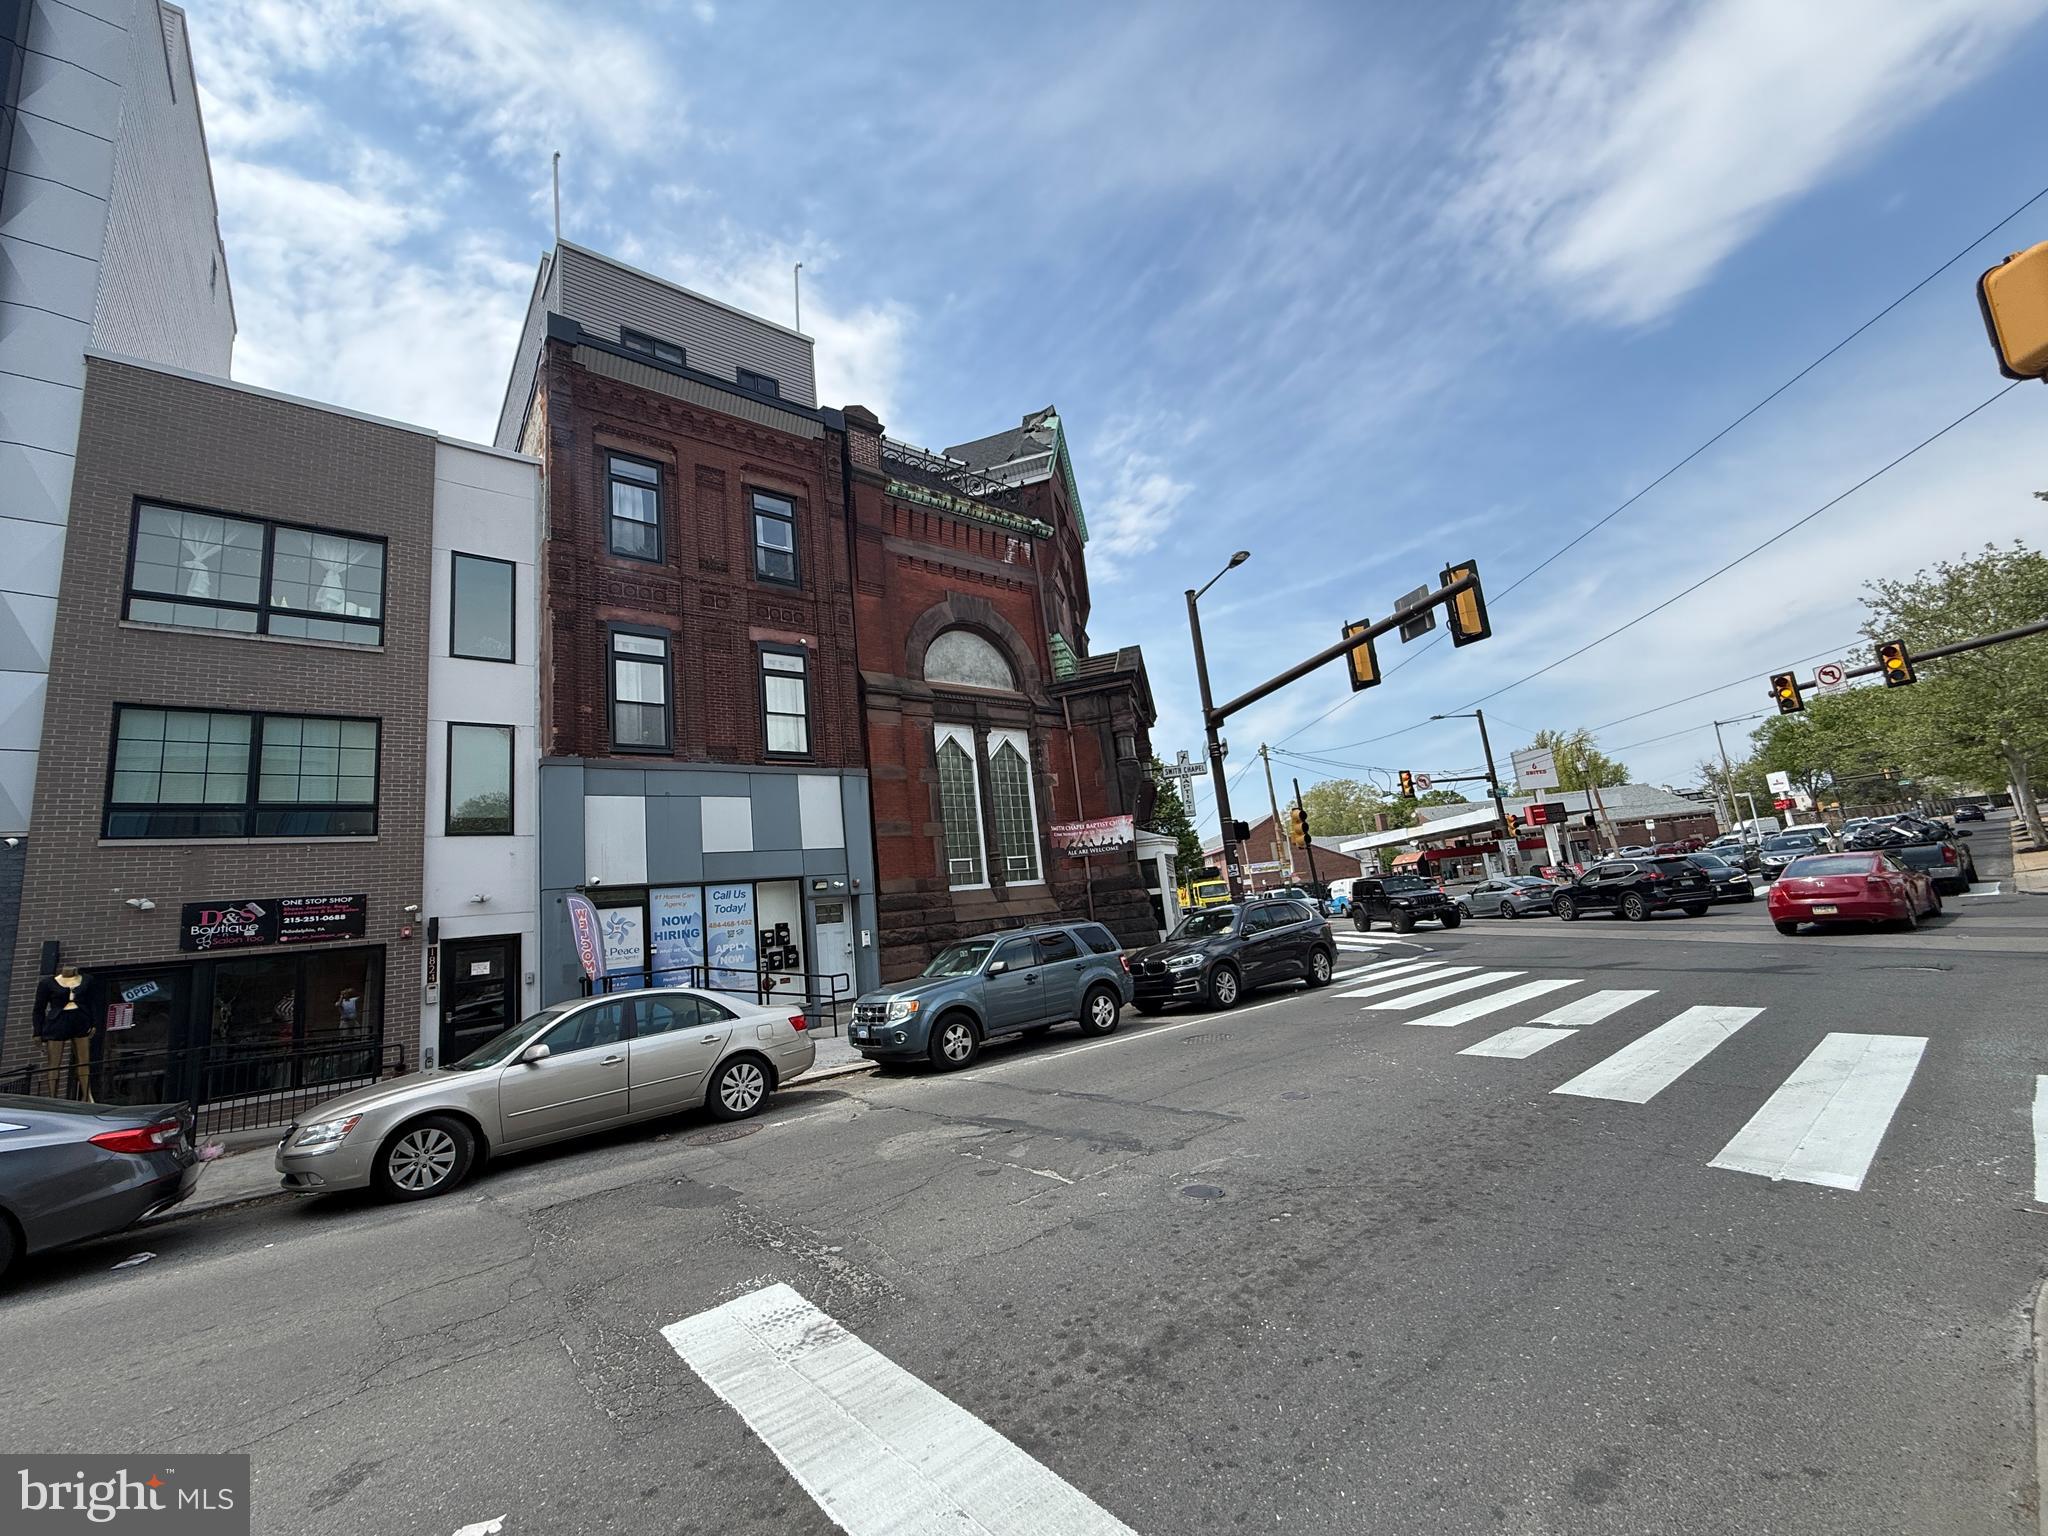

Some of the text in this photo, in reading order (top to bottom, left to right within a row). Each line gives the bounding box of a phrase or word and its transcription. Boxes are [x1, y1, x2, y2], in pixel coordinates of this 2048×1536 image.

[1165, 765, 1205, 776] SMITH CHAPEL
[1182, 773, 1192, 810] BAPTIST
[1065, 823, 1085, 831] CHAPEL
[1086, 821, 1109, 829] BAPTIST
[1090, 845, 1120, 853] WELCOME
[329, 896, 353, 904] SHOP
[713, 889, 746, 900] Call Us
[714, 902, 747, 914] Today!
[199, 908, 256, 926] D&S
[283, 914, 346, 924] 215-251-0688
[661, 915, 692, 926] NOW
[191, 923, 259, 936] Boutique
[654, 928, 700, 941] HIRING
[212, 937, 244, 945] Salon
[609, 947, 640, 956] Peace
[715, 943, 748, 954] APPLY
[720, 954, 745, 964] NOW
[126, 983, 156, 1000] OPEN
